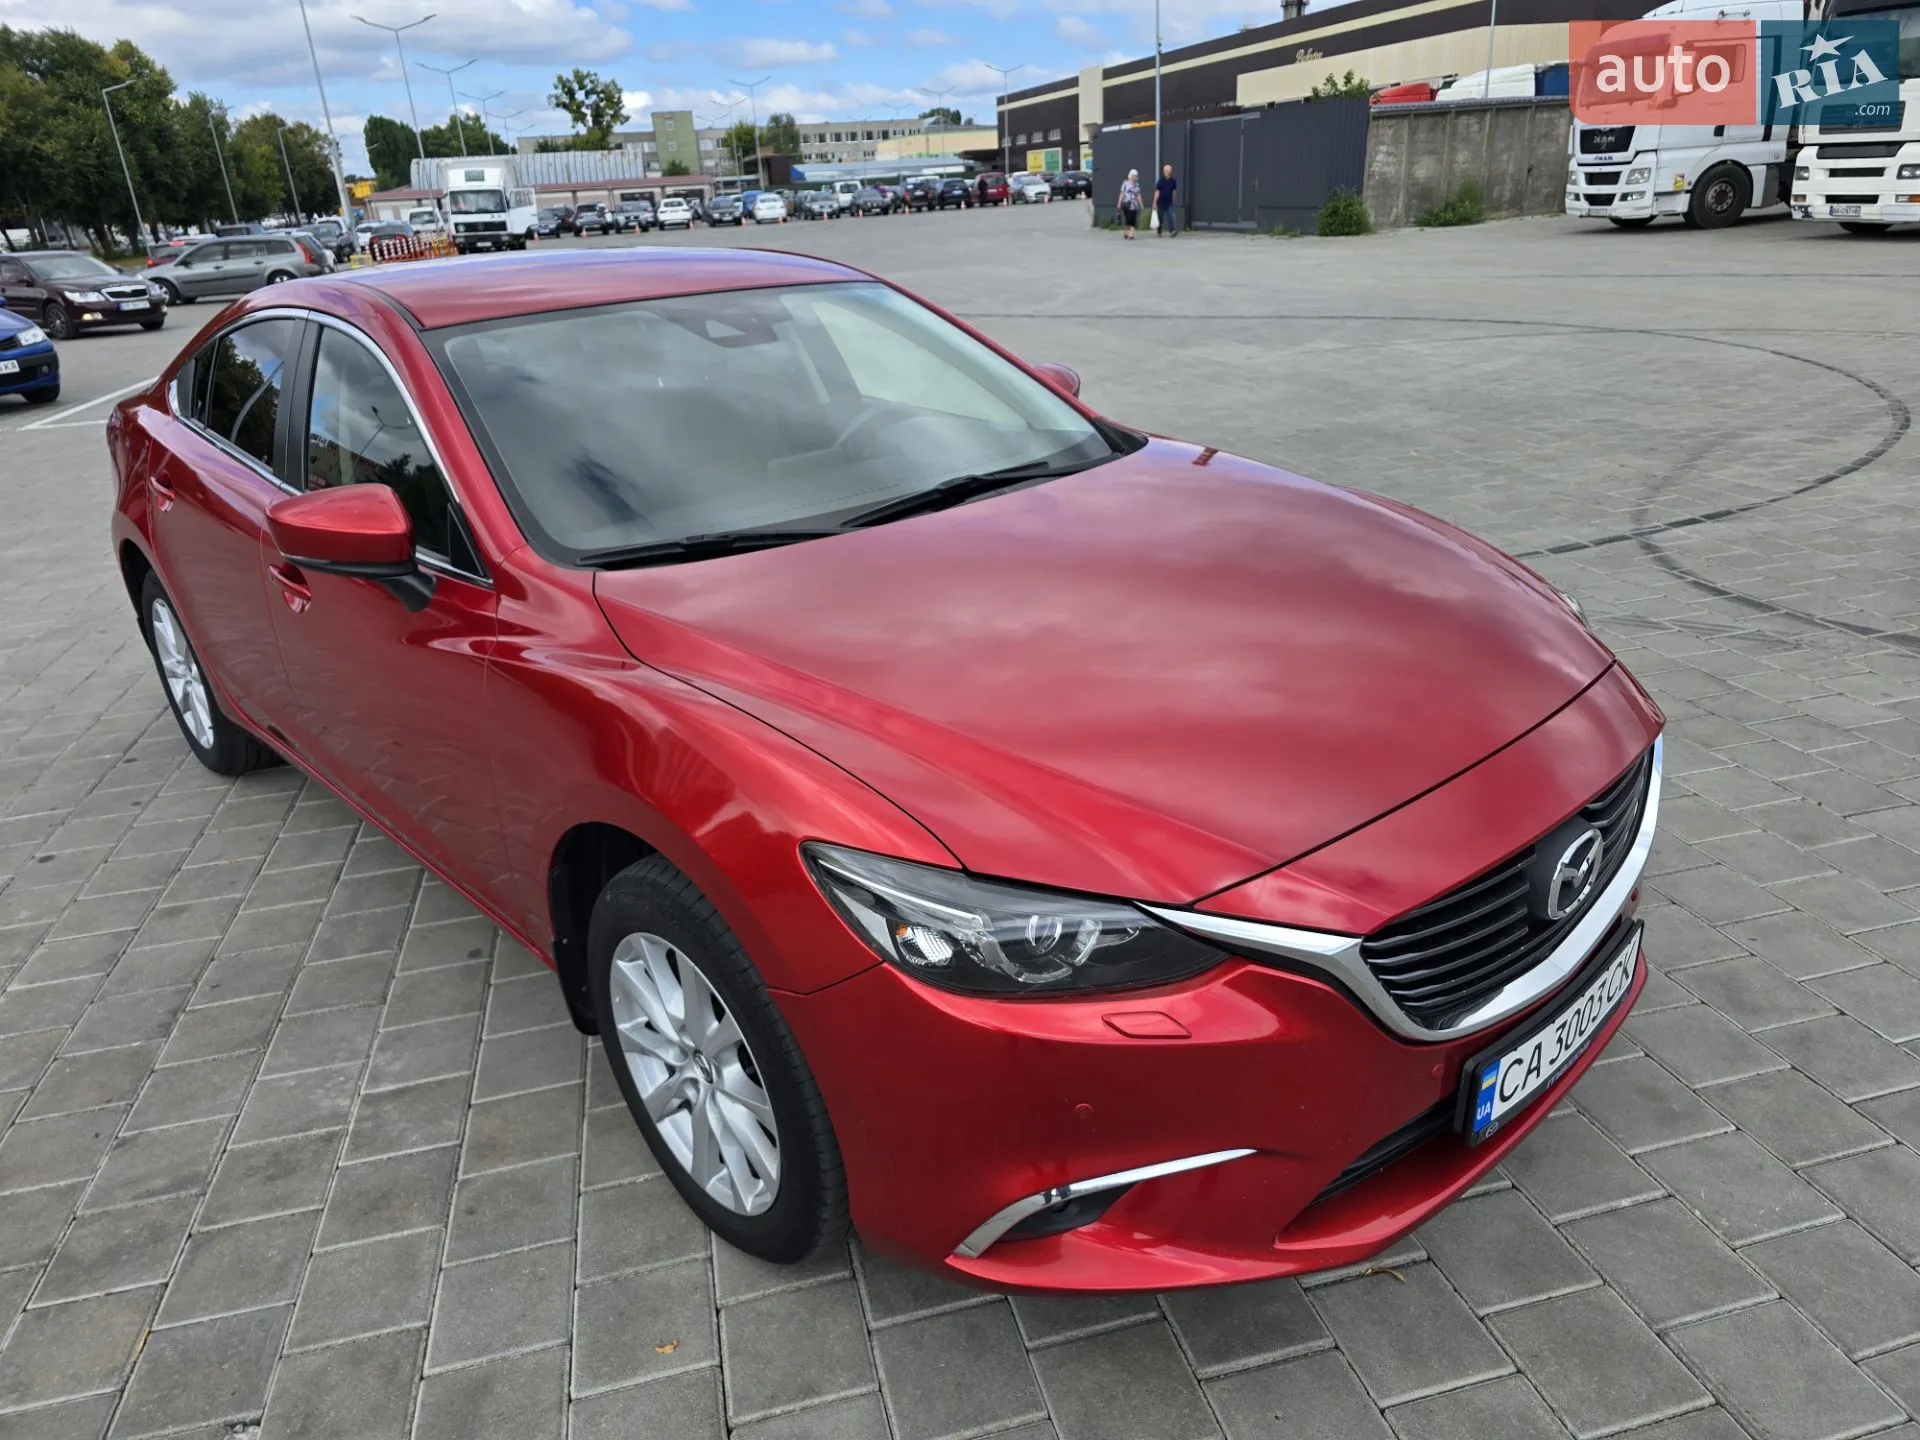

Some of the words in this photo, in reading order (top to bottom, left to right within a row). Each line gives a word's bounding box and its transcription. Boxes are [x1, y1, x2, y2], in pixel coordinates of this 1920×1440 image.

[1500, 1042, 1543, 1103] CA
[1549, 978, 1607, 1065] 3003
[1607, 940, 1637, 1003] CK
[1477, 1101, 1491, 1120] UA
